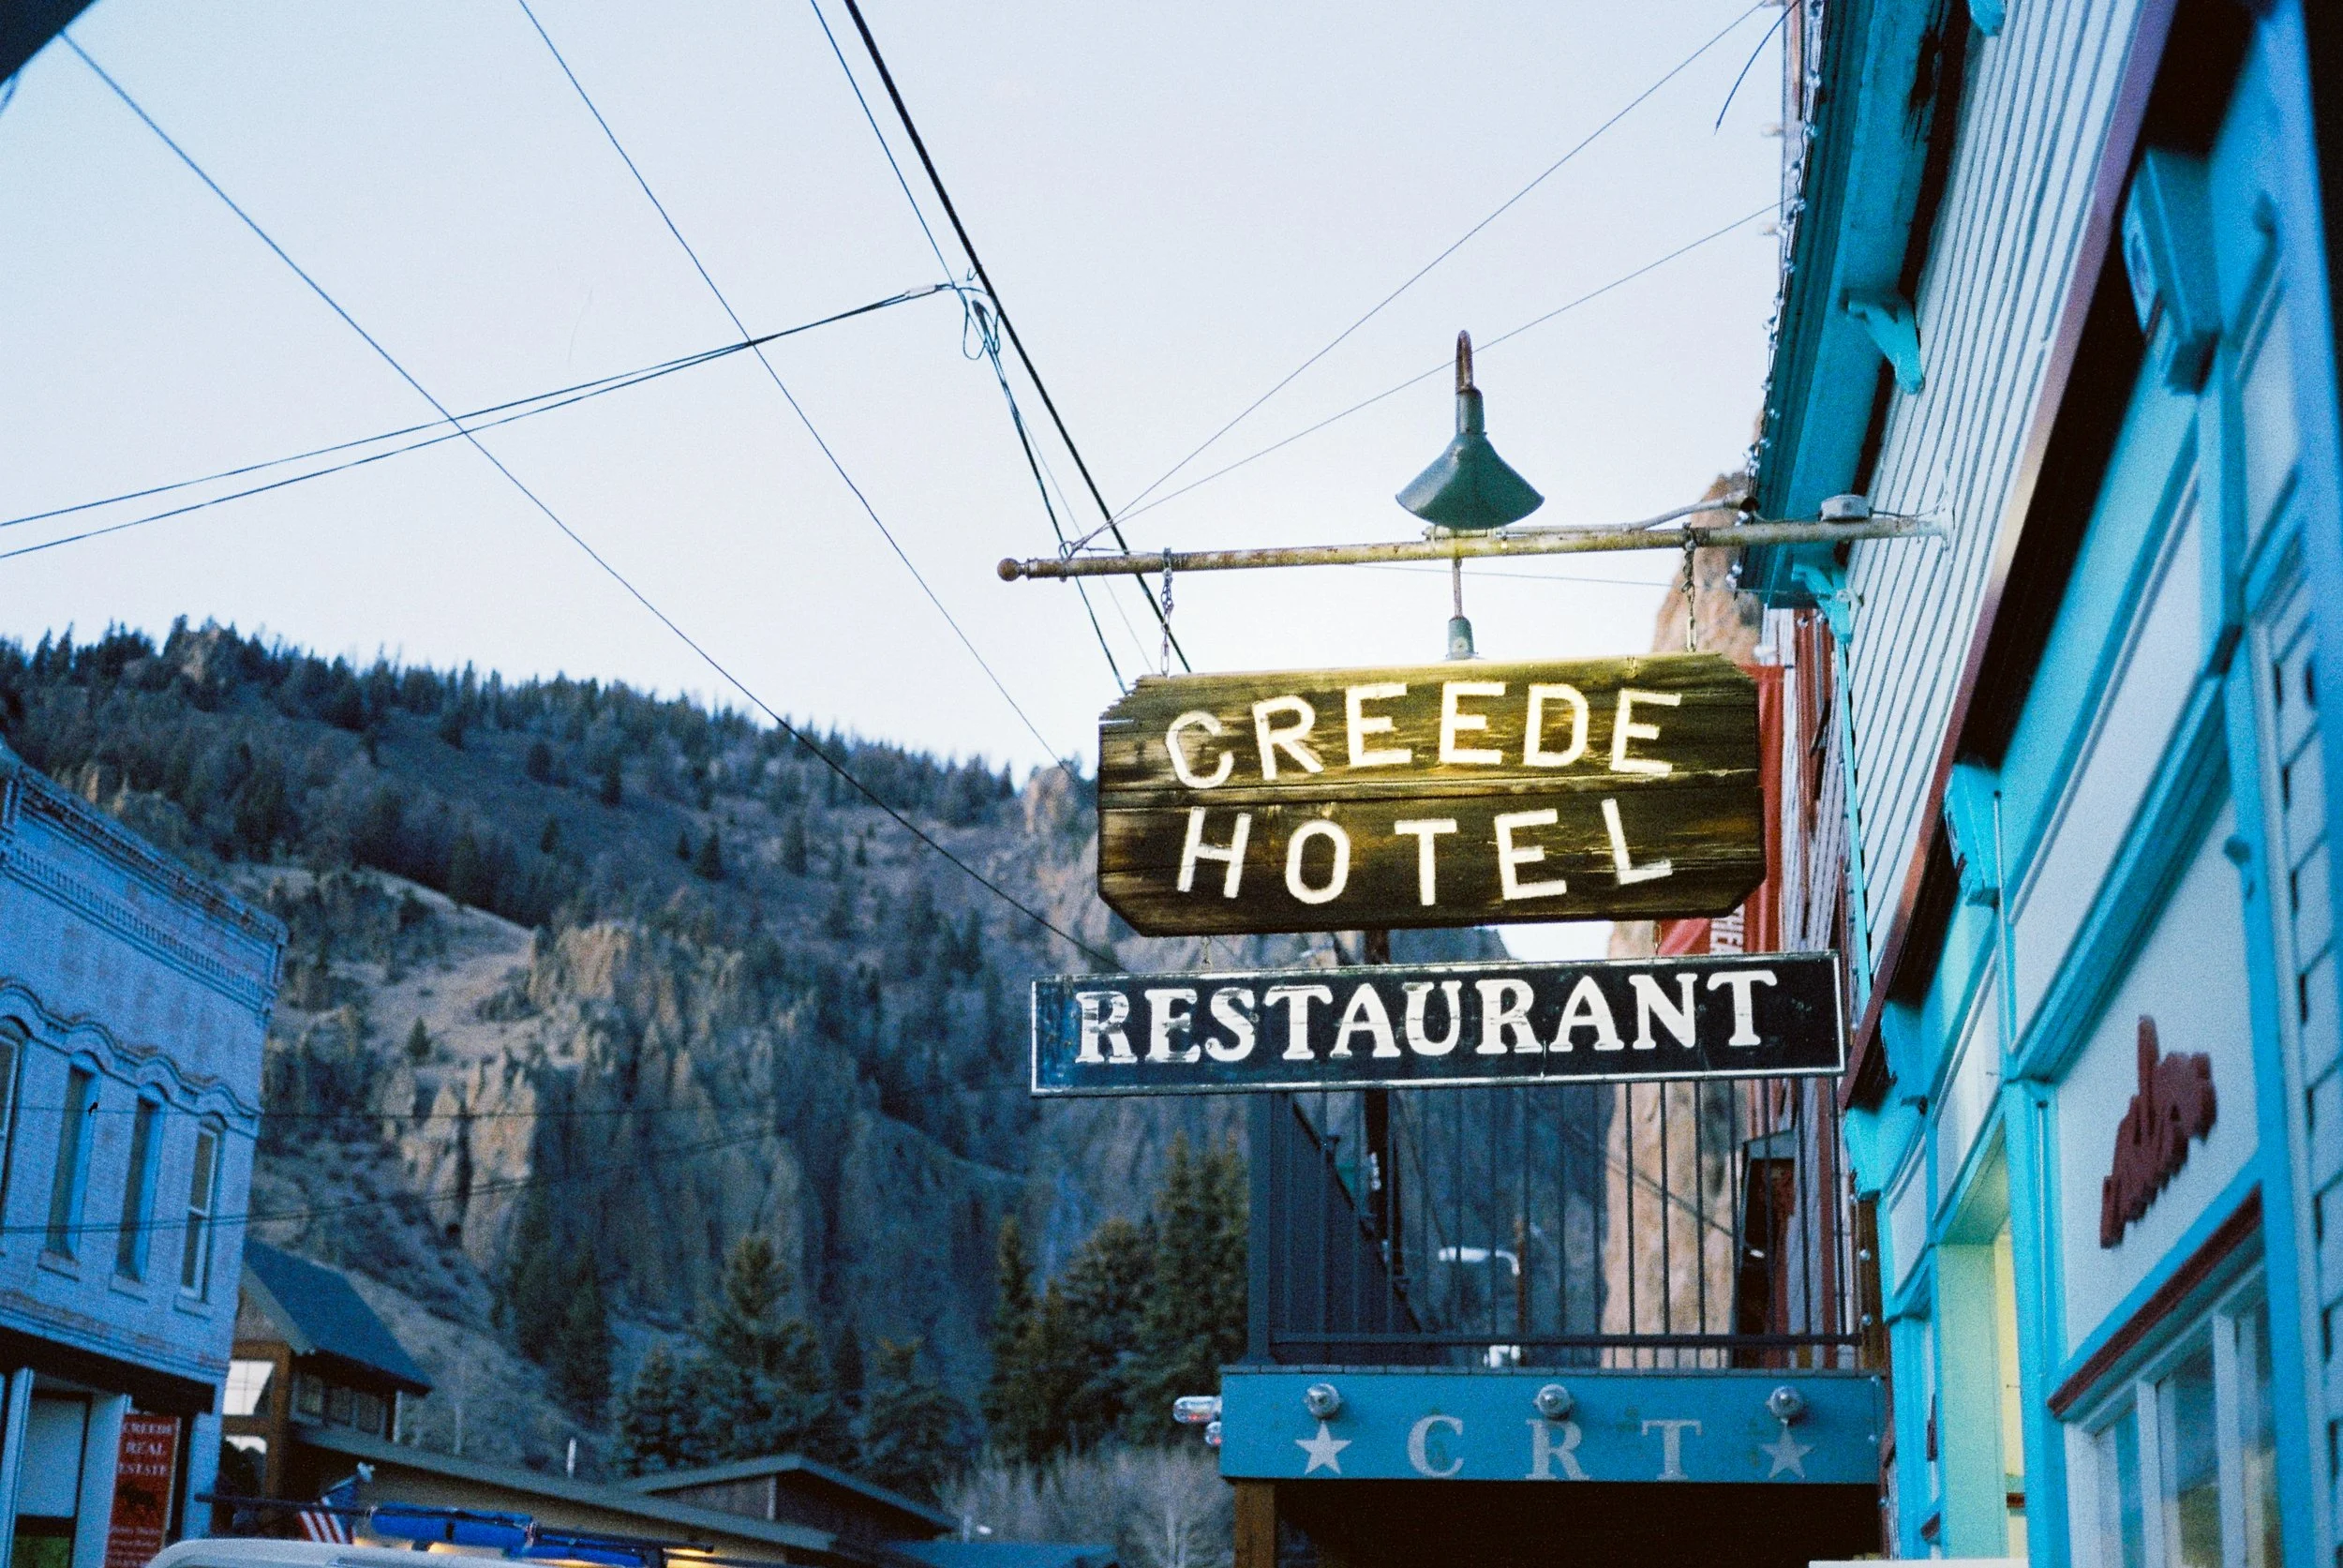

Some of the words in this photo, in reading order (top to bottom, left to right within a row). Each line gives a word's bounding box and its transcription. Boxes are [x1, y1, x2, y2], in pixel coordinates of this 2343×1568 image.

[1165, 681, 1682, 789] CREEDE
[1177, 798, 1673, 906] HOTEL
[1075, 969, 1778, 1065] RESTAURANT
[117, 1462, 168, 1477] ESTATE
[126, 1441, 166, 1456] REAL
